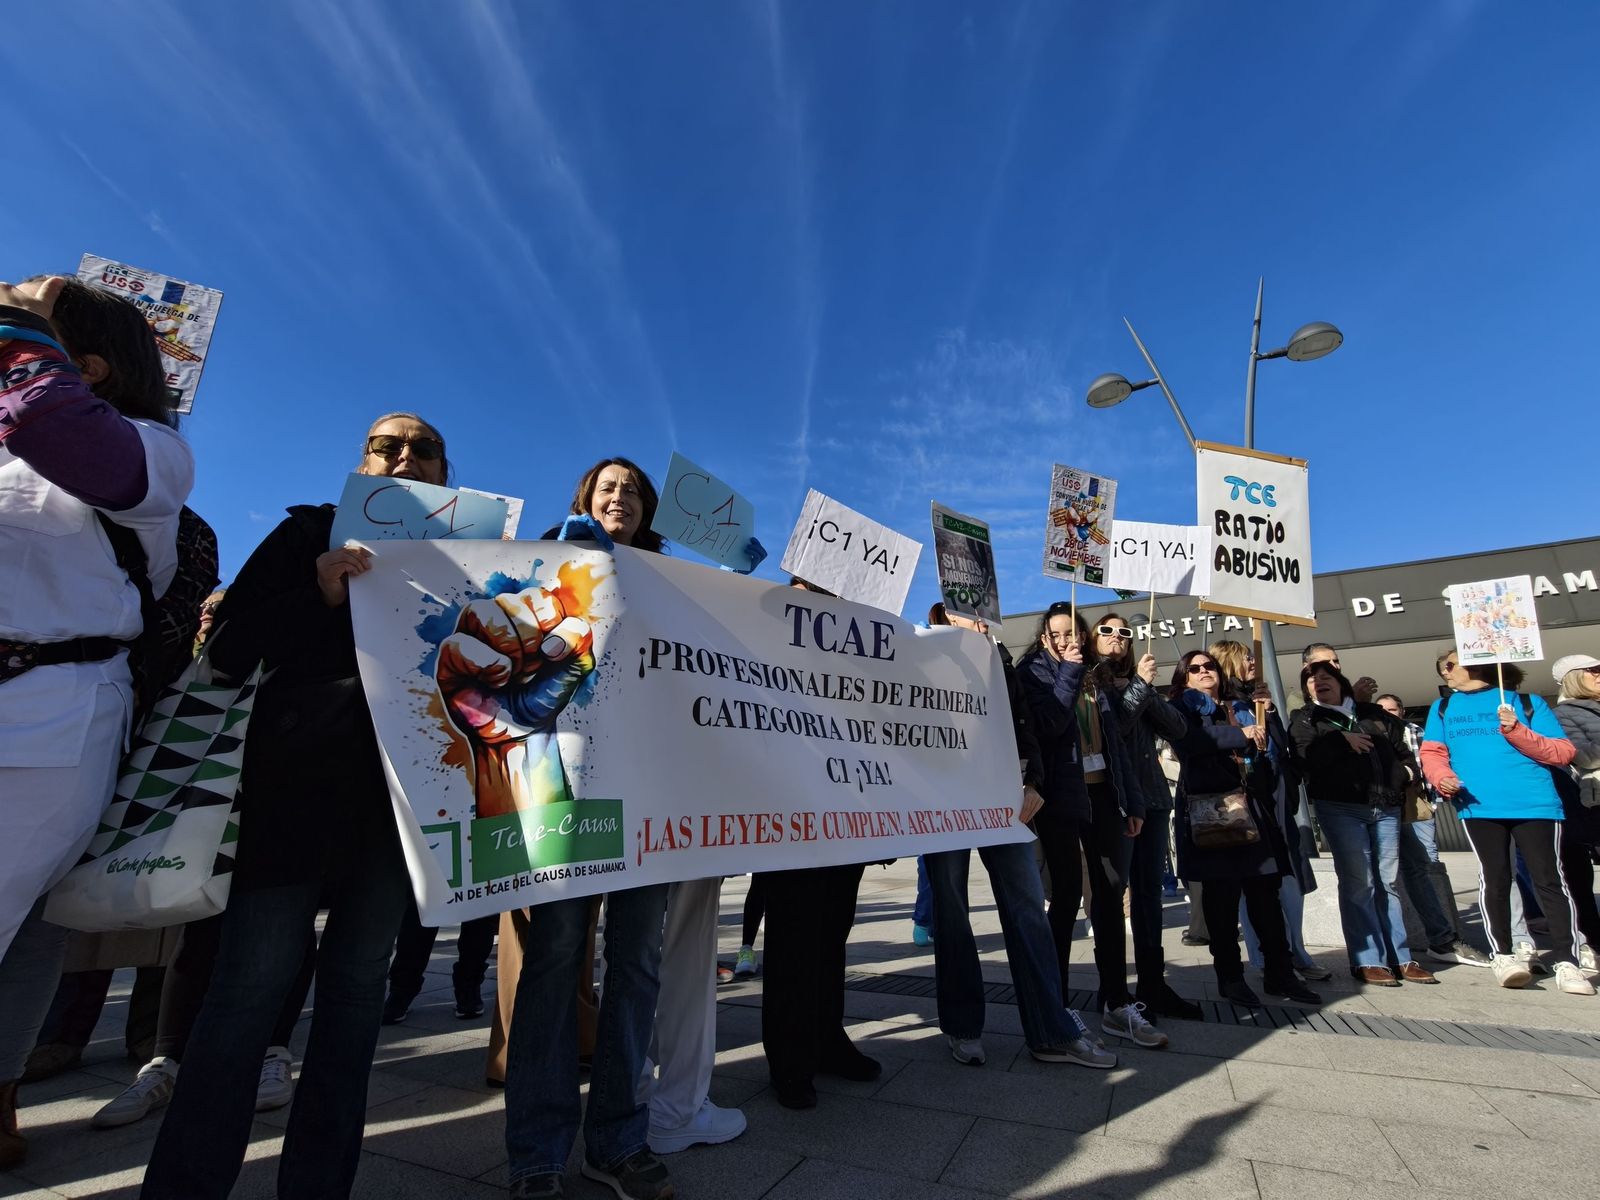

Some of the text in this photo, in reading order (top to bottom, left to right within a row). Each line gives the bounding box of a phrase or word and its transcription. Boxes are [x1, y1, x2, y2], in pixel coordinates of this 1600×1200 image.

[102, 272, 145, 292] USO
[145, 303, 184, 319] HUELGA
[186, 313, 201, 323] DE
[675, 472, 740, 527] C1
[1223, 475, 1277, 508] TCE
[807, 519, 899, 575] ¡C1 YA!
[1050, 546, 1102, 566] NOVIEMBRE
[1064, 538, 1090, 551] 28 DE
[1114, 538, 1194, 560] ¡C1 YA!
[942, 553, 955, 570] SI
[944, 568, 984, 588] MOVEMOS
[945, 588, 991, 611] TODO
[1351, 592, 1405, 617] DE
[784, 604, 896, 661] TCAE
[638, 637, 988, 716] ¡PROFESIONALES DE PRIMERA!
[692, 695, 968, 750] CATEGORIA DE SEGUNDA
[1456, 727, 1490, 738] HOSPITAL
[855, 759, 893, 793] ¡YA!
[490, 812, 619, 851] Tcae-Causa
[636, 806, 1014, 867] ¡LAS LEYES SE CUMPLEN! ART.76 DEL EBEP
[467, 886, 487, 901] DE
[484, 880, 510, 897] TCAE
[512, 873, 532, 890] DEL
[534, 867, 572, 884] CAUSA
[575, 865, 587, 877] DE
[588, 861, 627, 875] SALAMANCA
